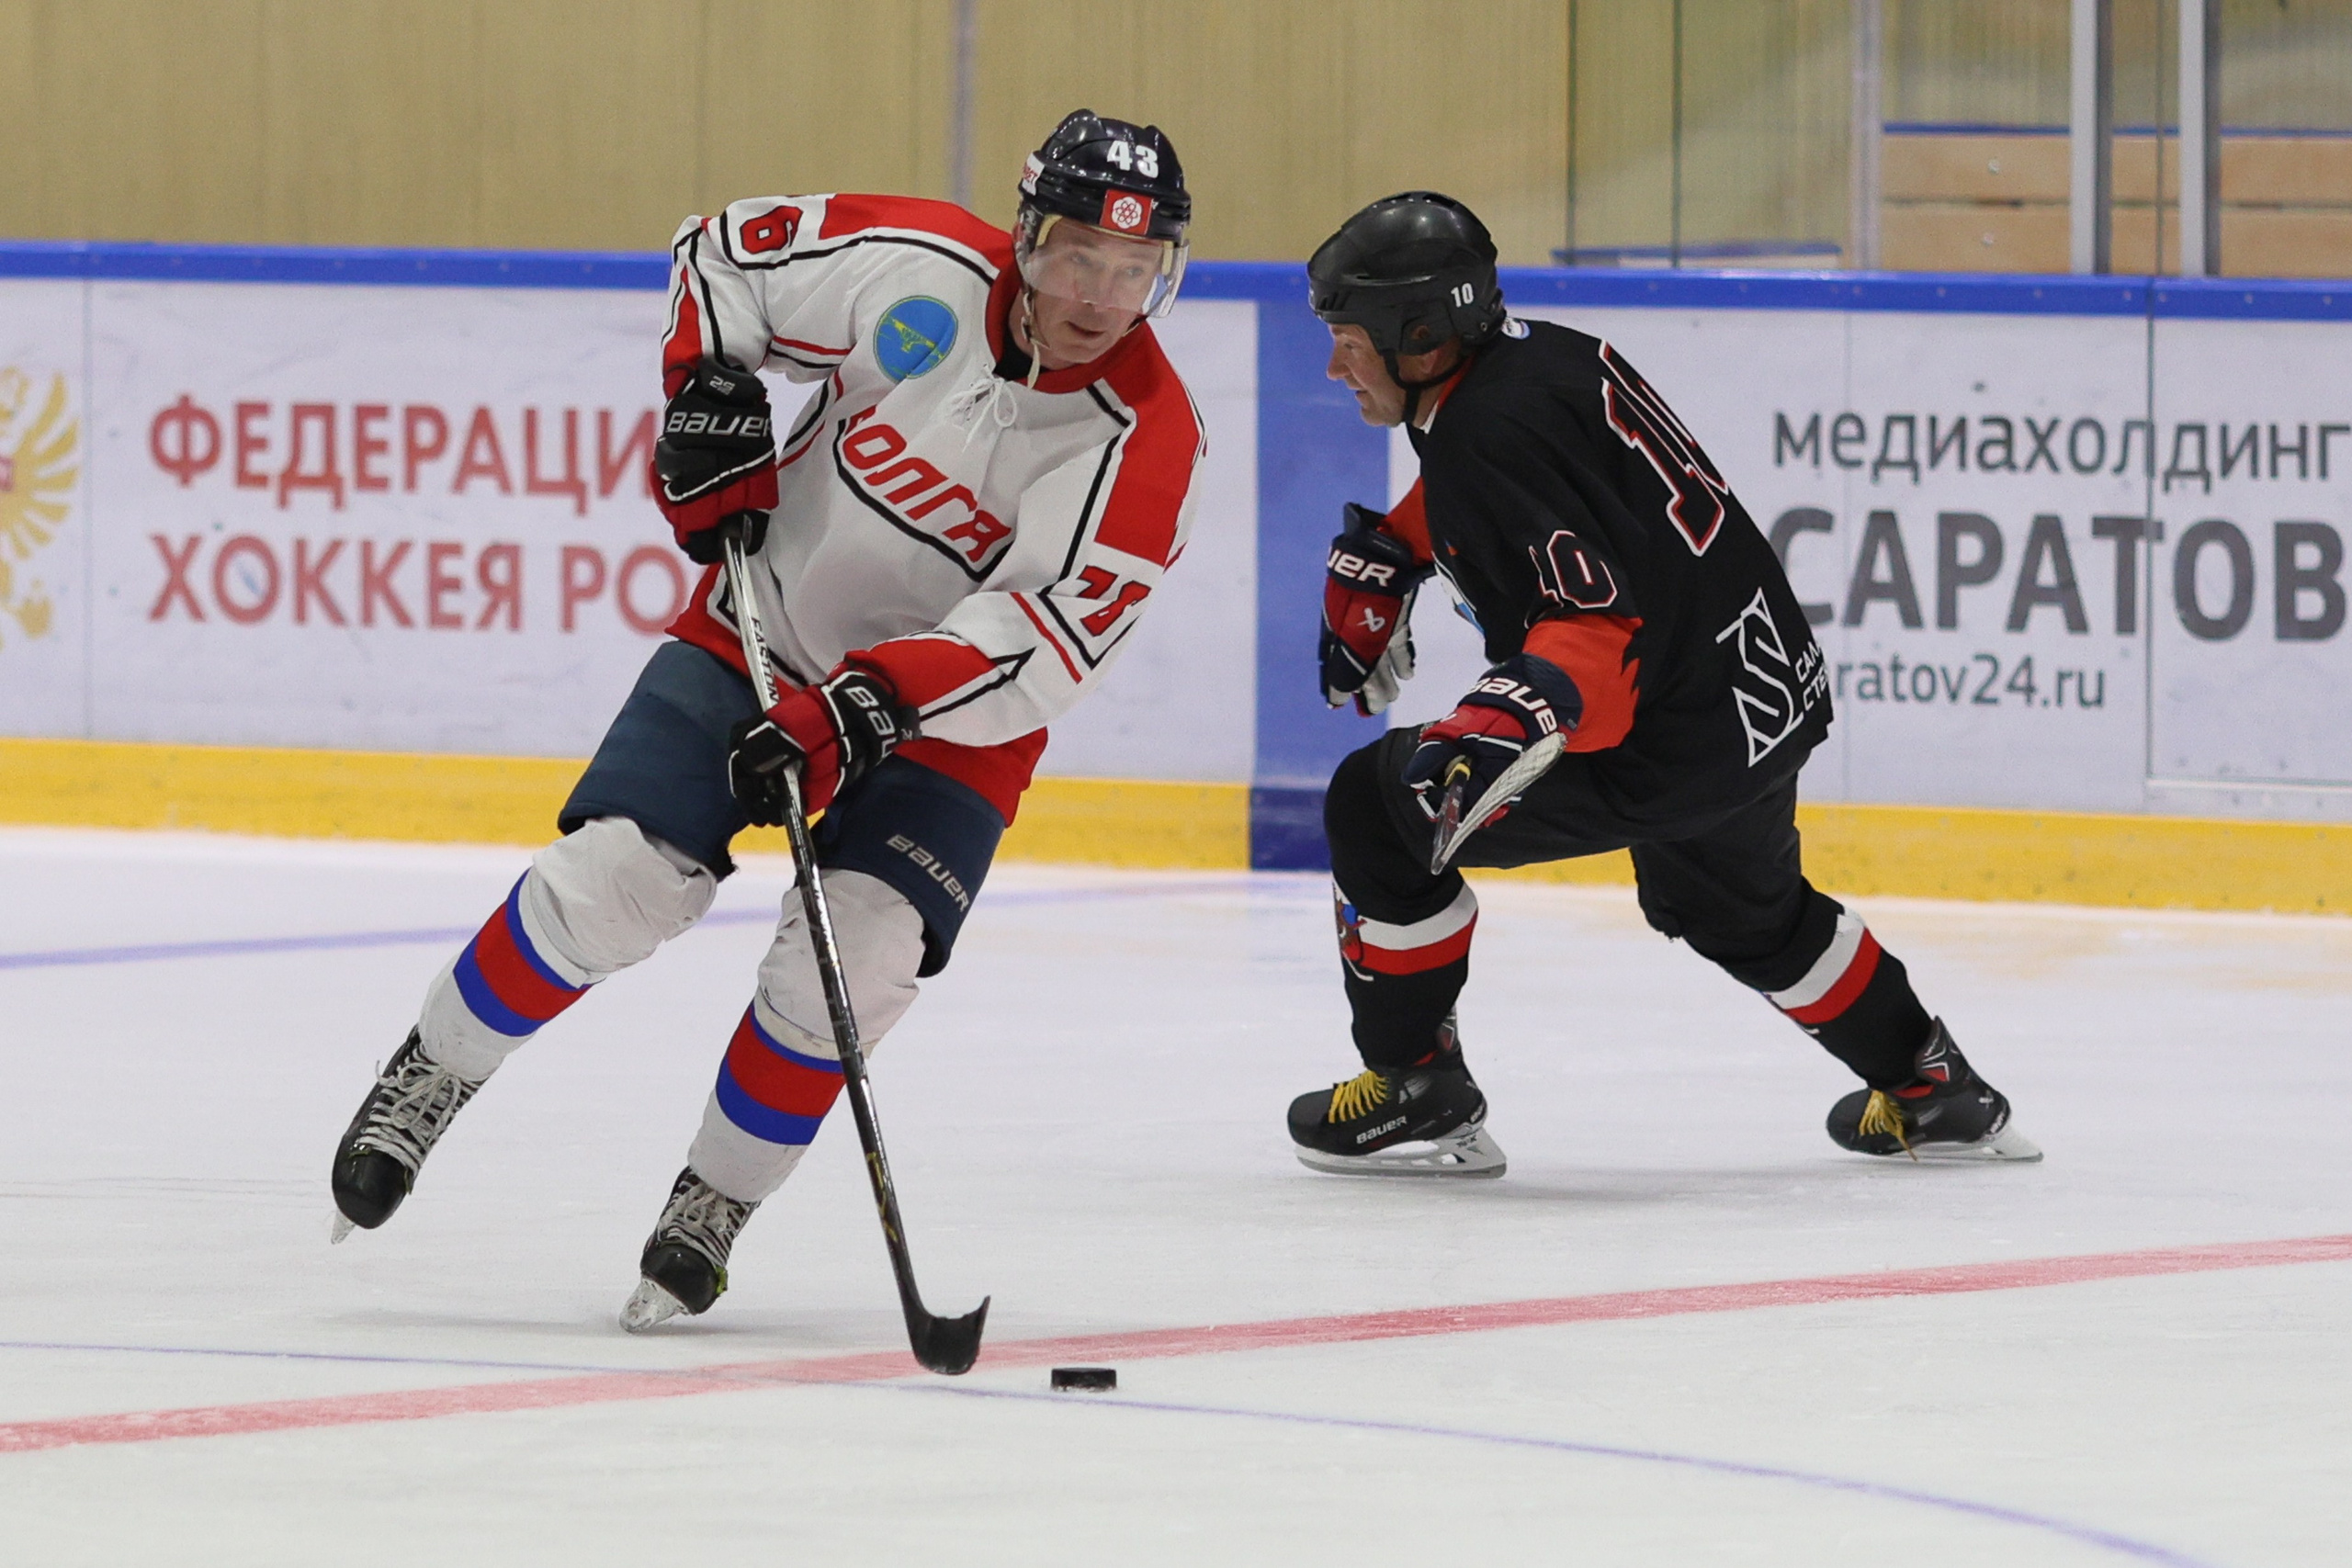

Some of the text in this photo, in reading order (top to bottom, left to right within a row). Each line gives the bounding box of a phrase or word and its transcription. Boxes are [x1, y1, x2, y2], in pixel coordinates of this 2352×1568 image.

[1107, 140, 1159, 178] 43
[1451, 283, 1474, 308] 10
[148, 393, 656, 516] ФЕДЕРАЦИ
[1773, 411, 2351, 494] медиахолдинг
[149, 533, 523, 634] ХОККЕЯ
[1768, 506, 2346, 641] САРАТОВ
[1837, 651, 2106, 707] ratov24.ru
[886, 834, 969, 913] BAUER
[1356, 1115, 1408, 1145] BAUER
